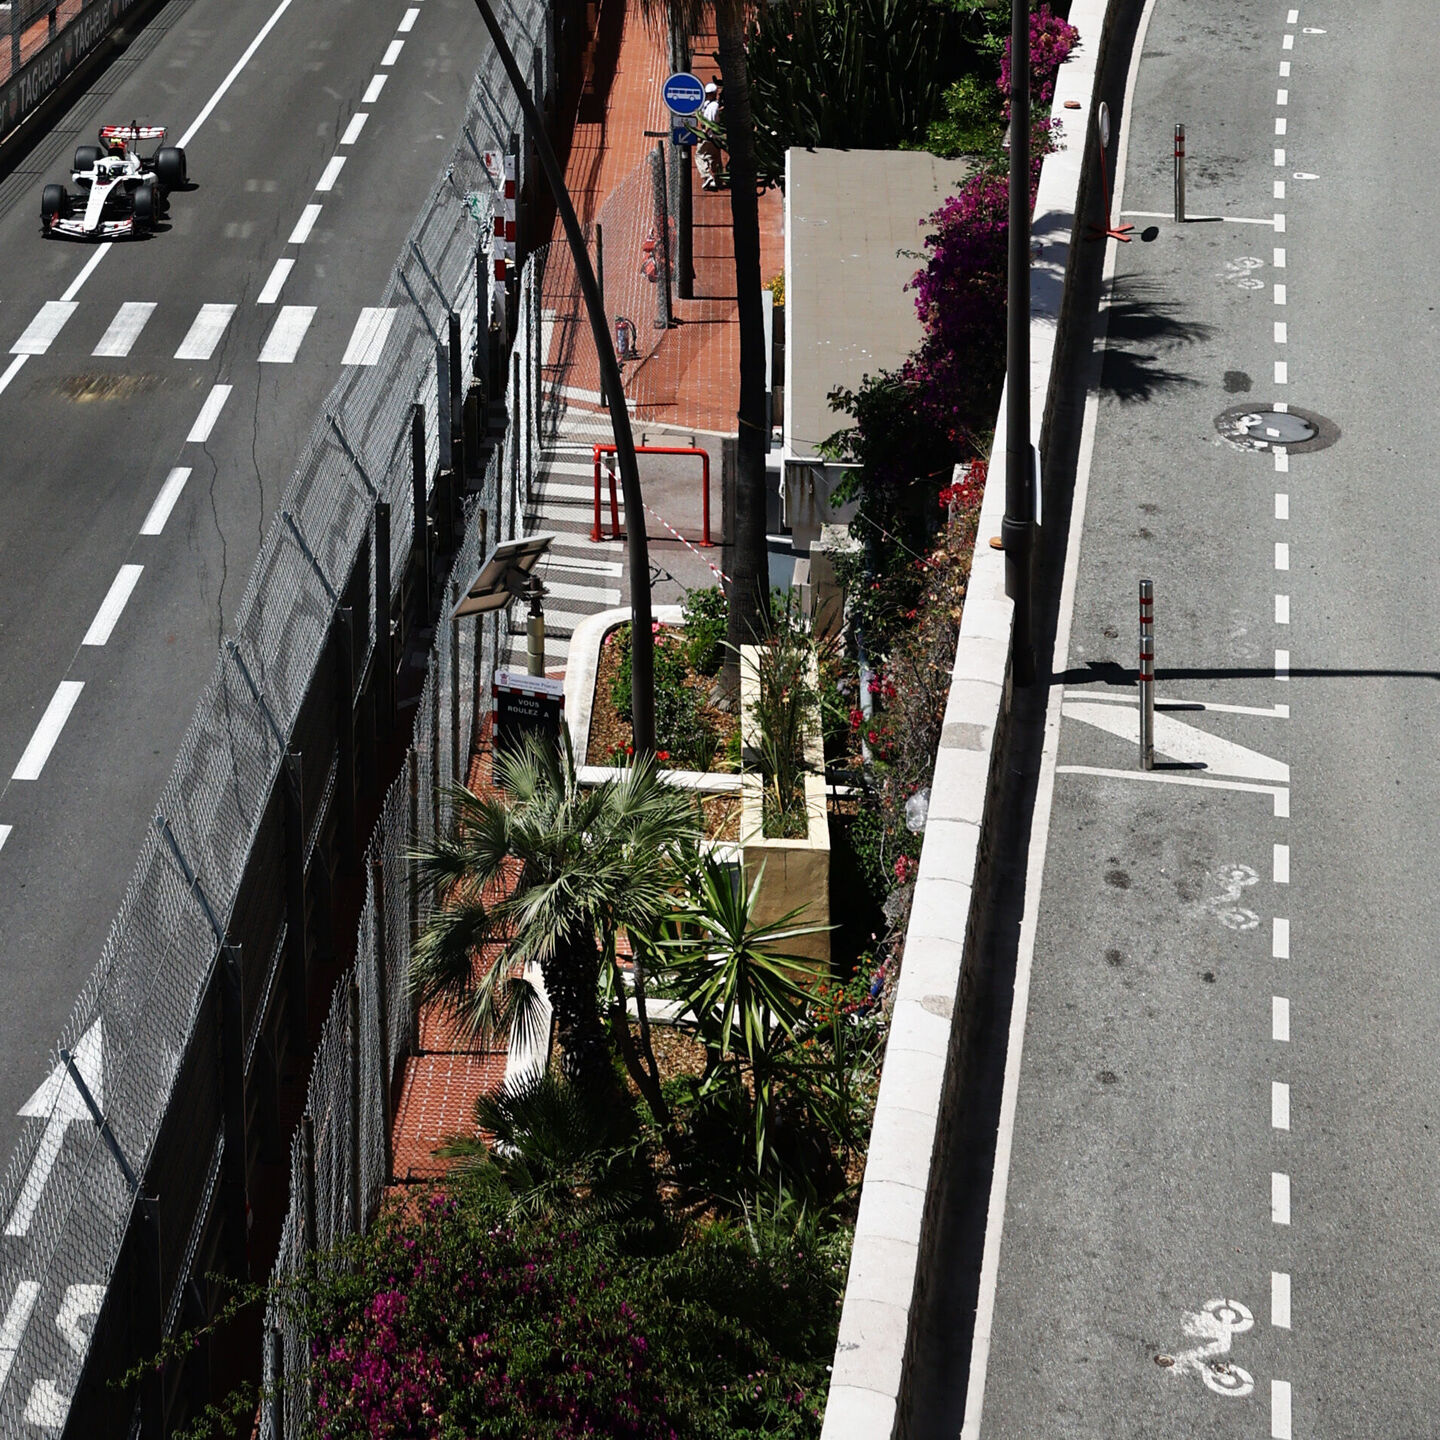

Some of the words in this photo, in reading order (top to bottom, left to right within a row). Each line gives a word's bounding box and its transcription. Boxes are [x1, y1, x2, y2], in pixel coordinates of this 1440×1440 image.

[517, 698, 540, 709] VOUS
[507, 705, 539, 717] ROULEZ
[543, 711, 550, 719] A
